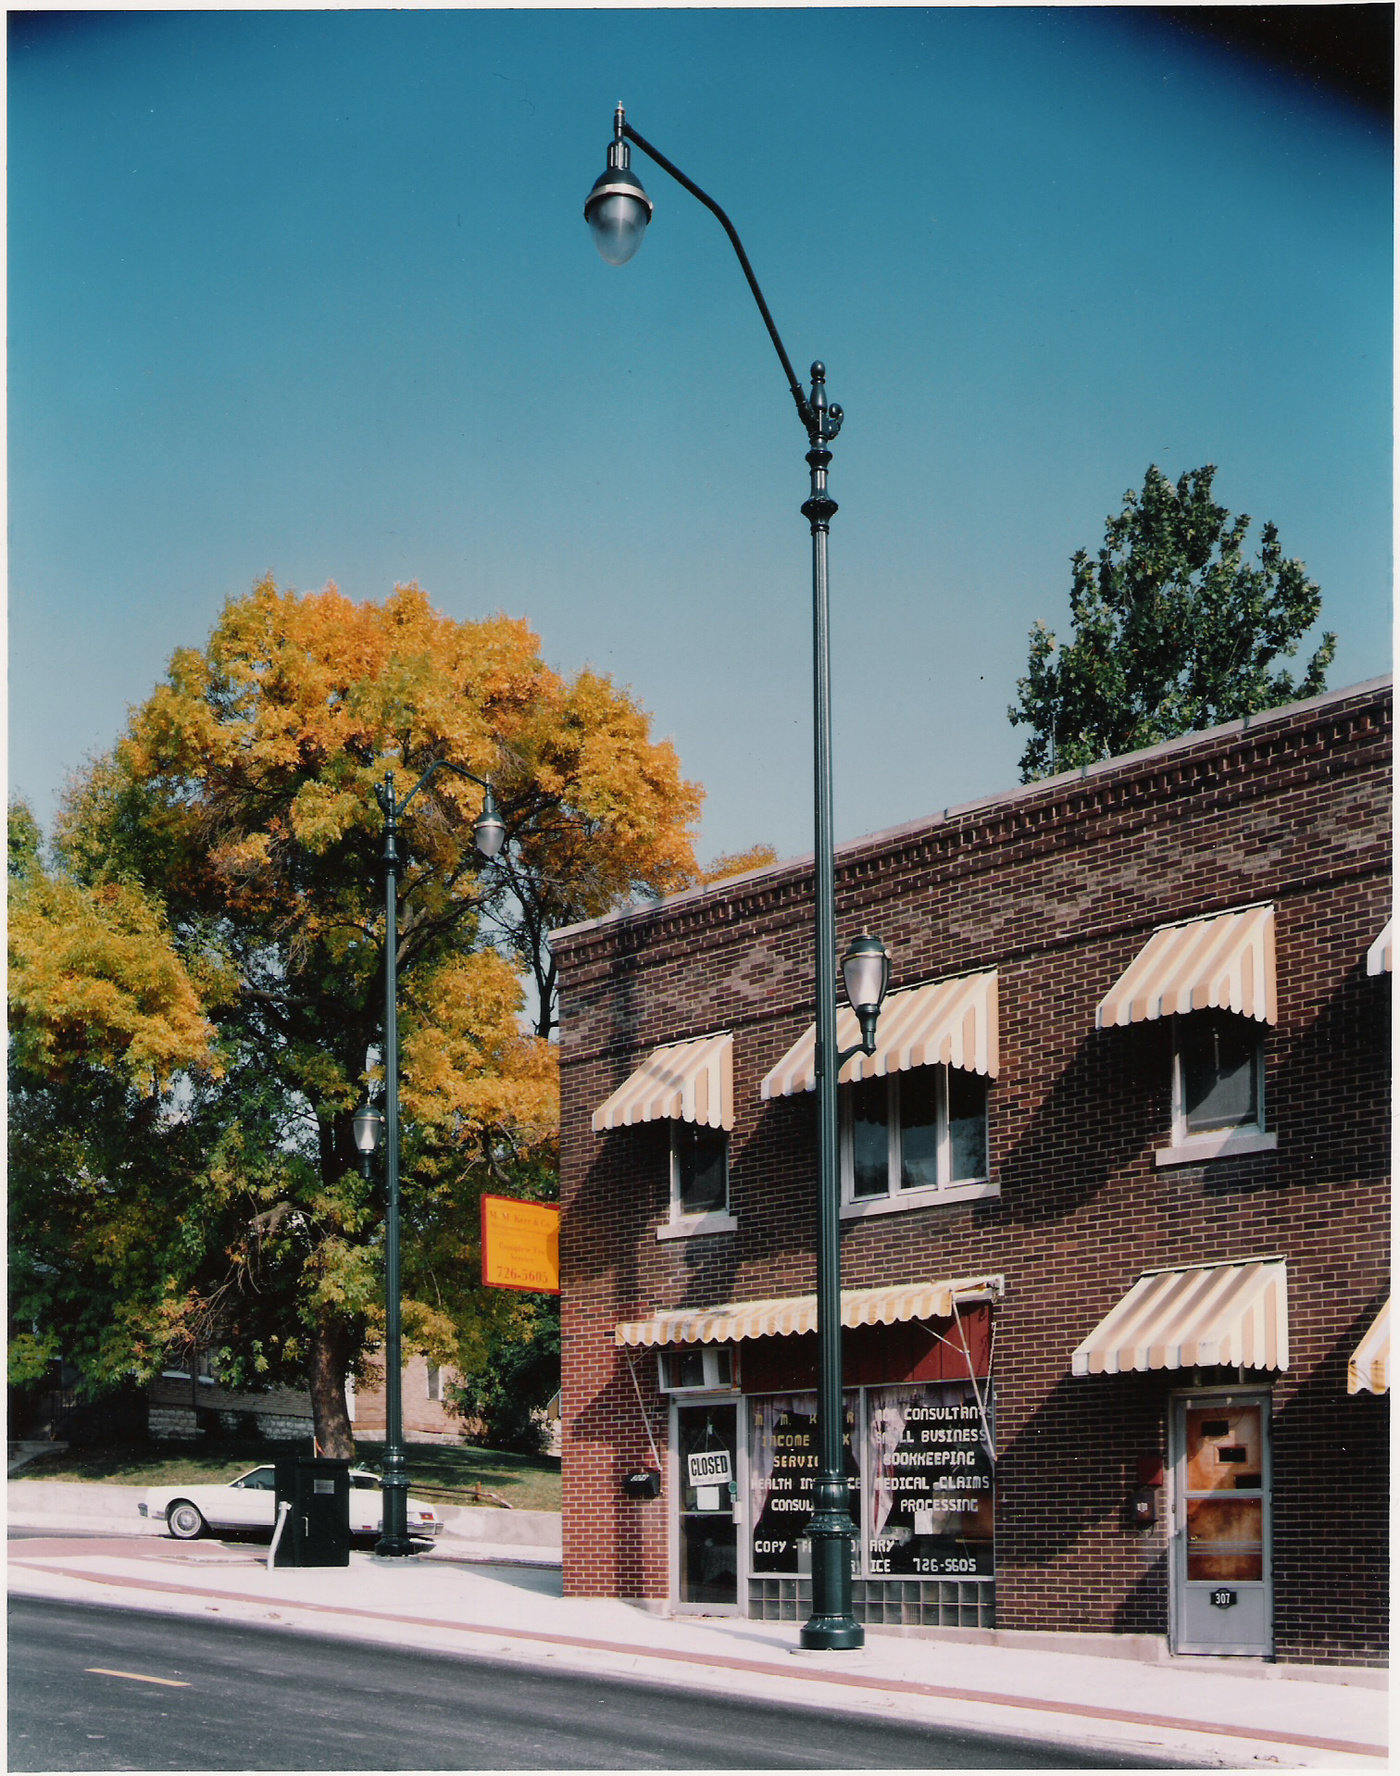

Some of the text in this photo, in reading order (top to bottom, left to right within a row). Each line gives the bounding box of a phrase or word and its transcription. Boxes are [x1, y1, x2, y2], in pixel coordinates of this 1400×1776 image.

[497, 1265, 548, 1283] 726-5605
[762, 1434, 810, 1447] INCOME
[921, 1428, 987, 1443] BUSINESS
[691, 1455, 728, 1477] CLOSED
[883, 1451, 975, 1466] BOOKKEEPING
[939, 1475, 990, 1489] CLAIMS
[900, 1498, 978, 1513] PROCESSING
[755, 1540, 786, 1553] COPY
[913, 1557, 976, 1572] 726-5605
[1215, 1593, 1230, 1604] 307
